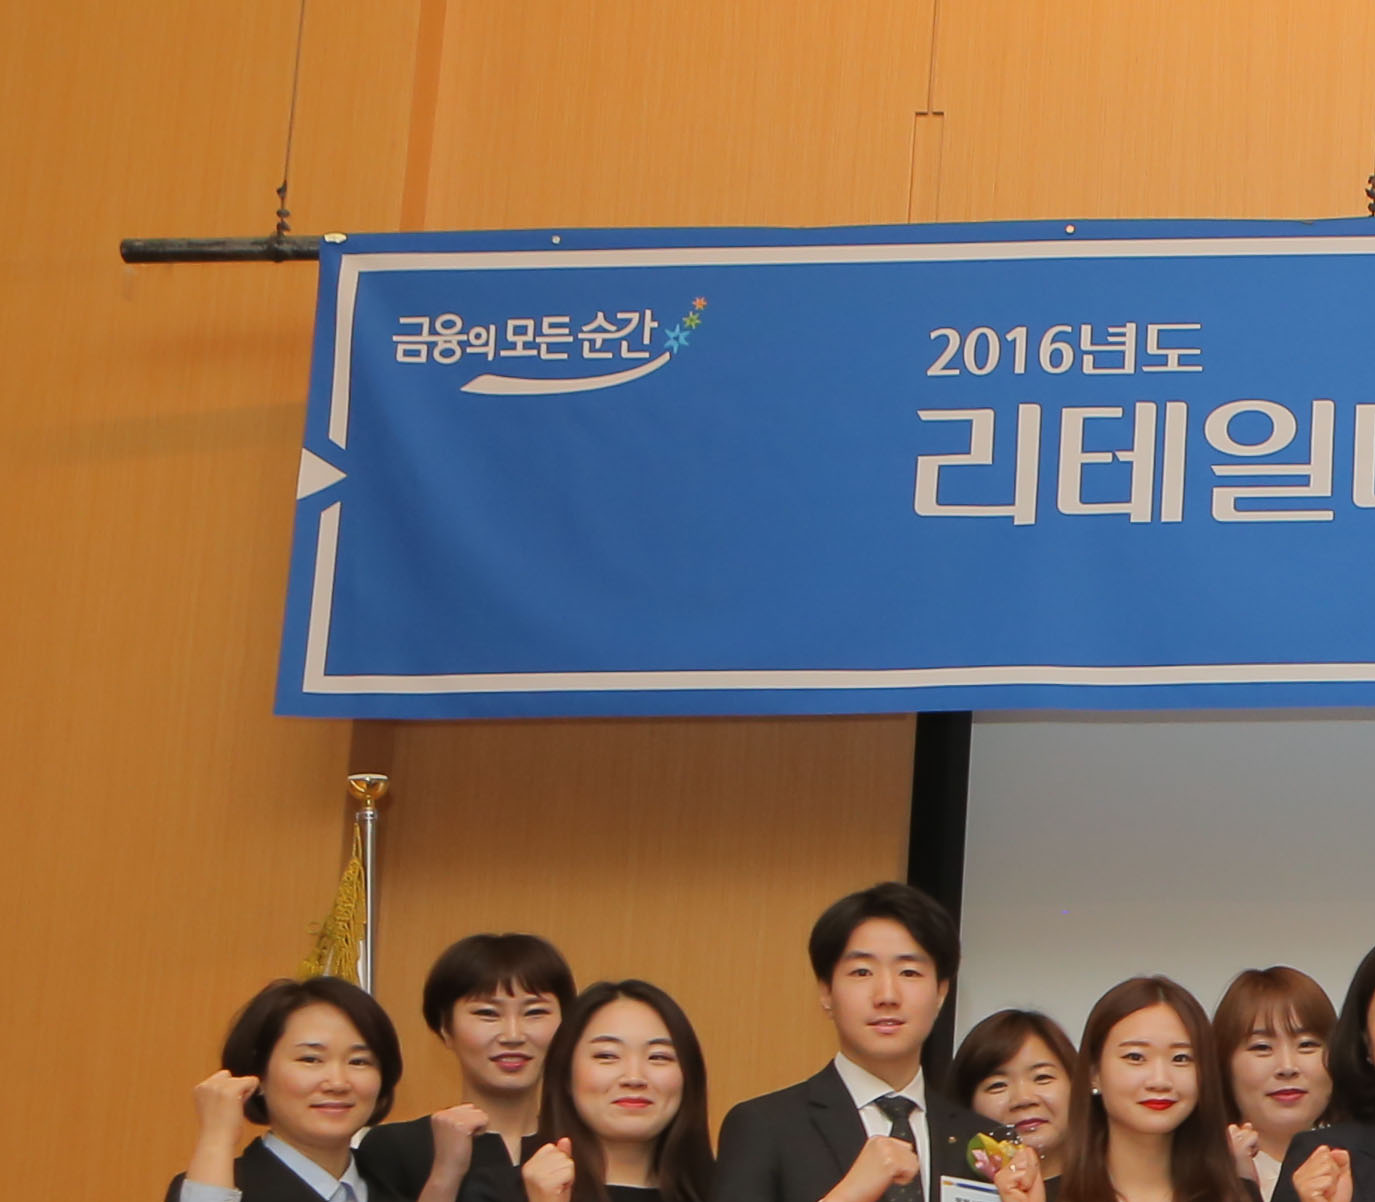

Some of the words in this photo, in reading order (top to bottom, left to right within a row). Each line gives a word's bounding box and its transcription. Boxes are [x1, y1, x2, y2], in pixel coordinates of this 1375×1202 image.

[392, 313, 496, 364] 금융의
[499, 315, 574, 360] 모든
[577, 309, 659, 360] 순간
[927, 322, 1202, 376] 2016년도
